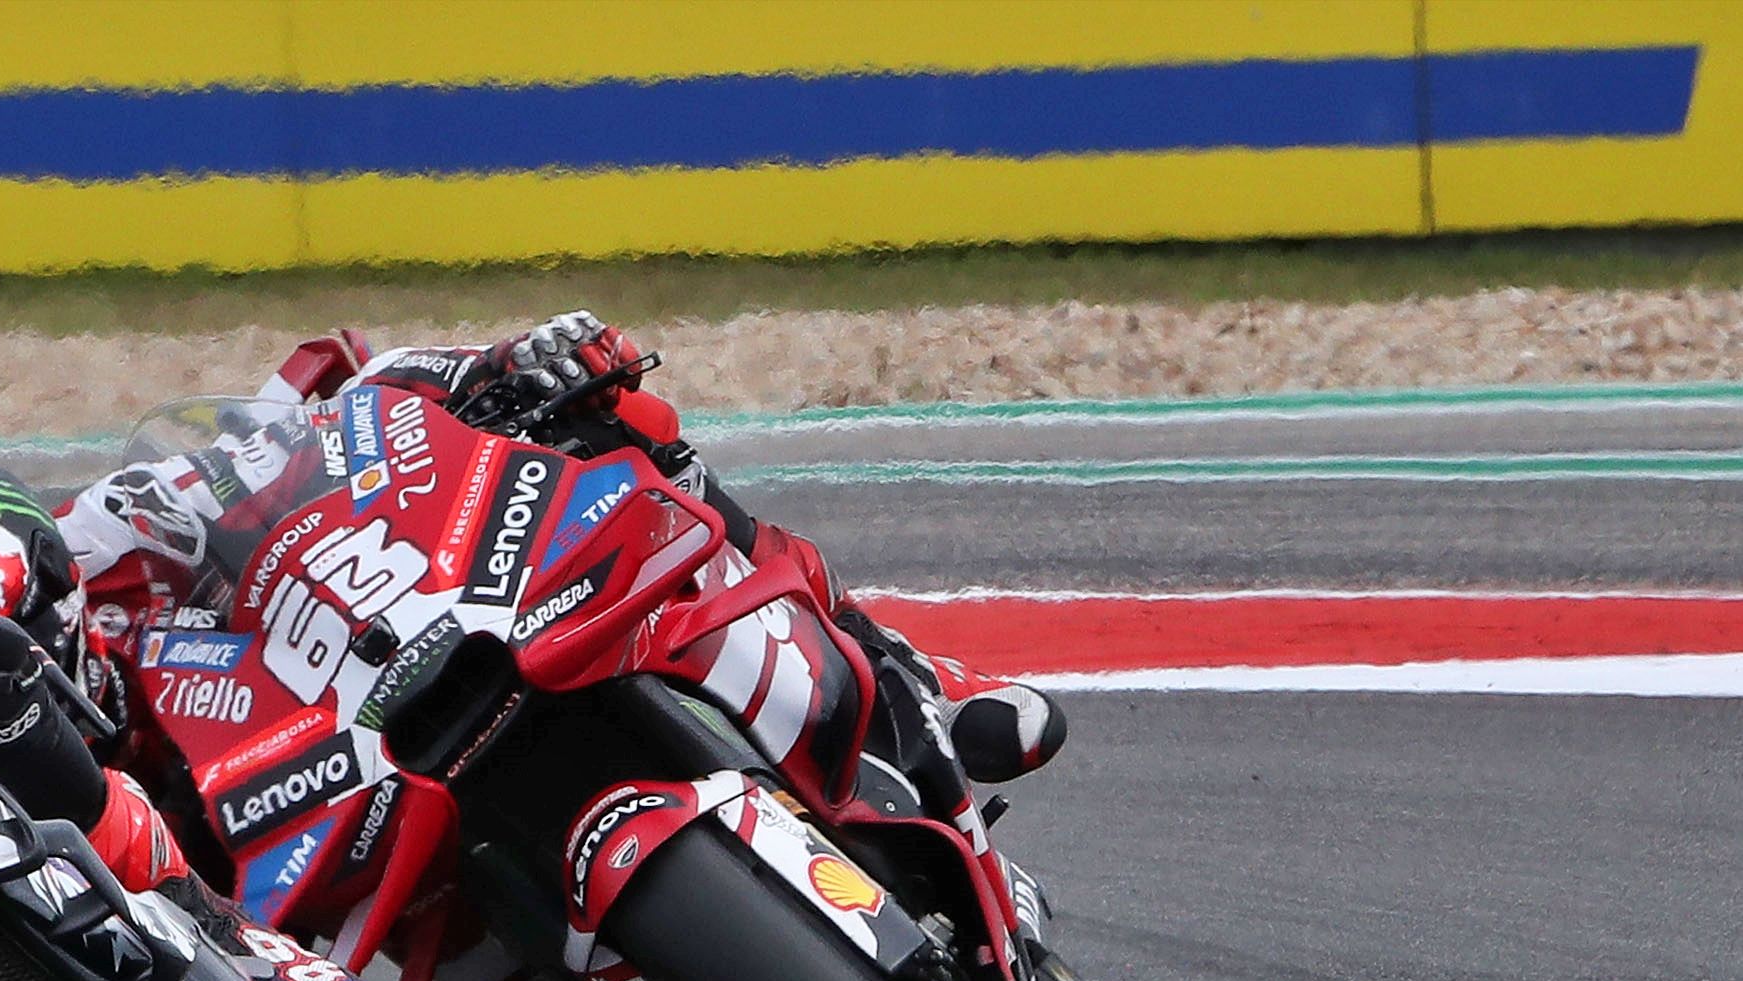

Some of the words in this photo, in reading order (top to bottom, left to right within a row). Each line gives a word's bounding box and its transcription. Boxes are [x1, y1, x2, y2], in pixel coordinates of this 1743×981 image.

[354, 392, 378, 456] ADVANCE
[385, 396, 433, 474] riello
[450, 439, 498, 545] FRECCIAROSSA
[473, 460, 548, 597] Lenovo
[581, 481, 632, 524] TIM
[244, 511, 324, 609] VARGROUP
[261, 517, 430, 706] 63
[512, 578, 595, 641] CARRERA
[171, 671, 255, 725] riello
[373, 618, 459, 705] MONSTER
[221, 752, 350, 837] Lenovo
[351, 778, 398, 861] CARRERA
[276, 833, 318, 887] TIM
[573, 795, 666, 907] Lenovo
